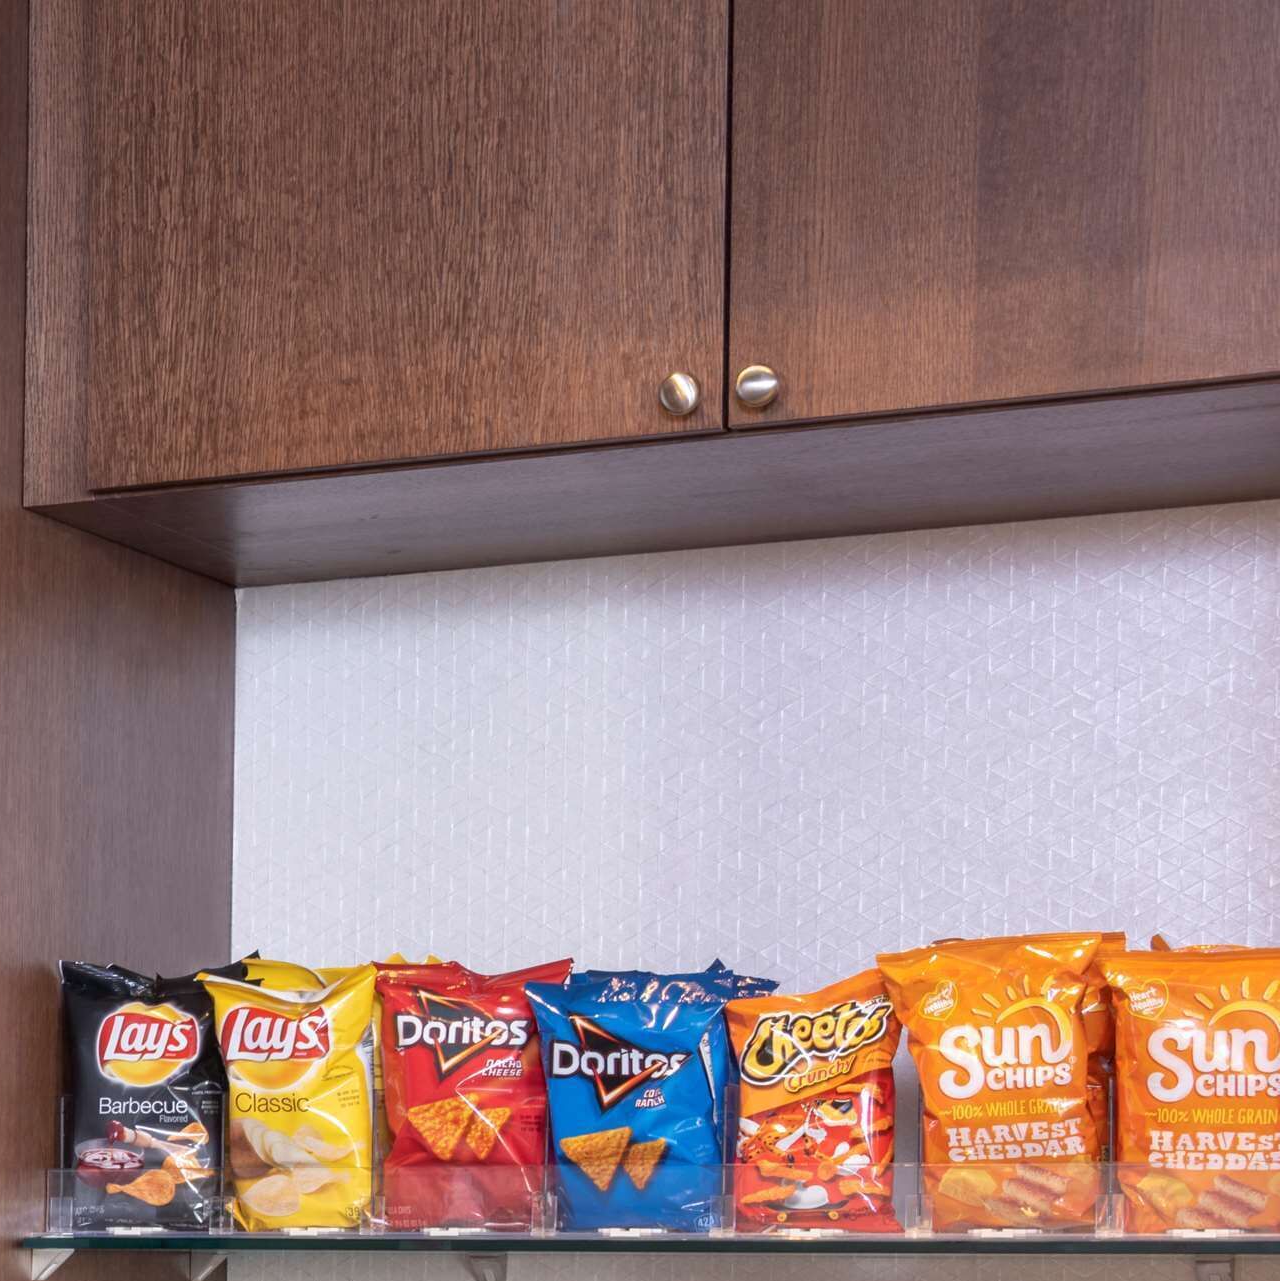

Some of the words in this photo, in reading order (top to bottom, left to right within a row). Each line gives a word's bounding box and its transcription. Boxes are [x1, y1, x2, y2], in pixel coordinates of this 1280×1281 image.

[396, 1016, 528, 1047] Doritos
[742, 1002, 892, 1079] Cheetos
[553, 1040, 690, 1078] Doritos
[939, 1023, 1073, 1100] Sun
[482, 1068, 522, 1077] CHEESE
[784, 1055, 855, 1093] Crunchy
[987, 1066, 1072, 1090] CHIPS
[99, 1097, 188, 1114] Barbecue
[235, 1092, 310, 1113] Classic
[635, 1095, 665, 1108] RANCH
[985, 1102, 1027, 1118] WHOLE
[159, 1114, 188, 1123] Flavored
[1193, 1108, 1233, 1123] WHOLE
[1238, 1108, 1278, 1124] GRAIN
[947, 1118, 1082, 1148] HARVEST
[948, 1136, 1086, 1163] CHEDDAR
